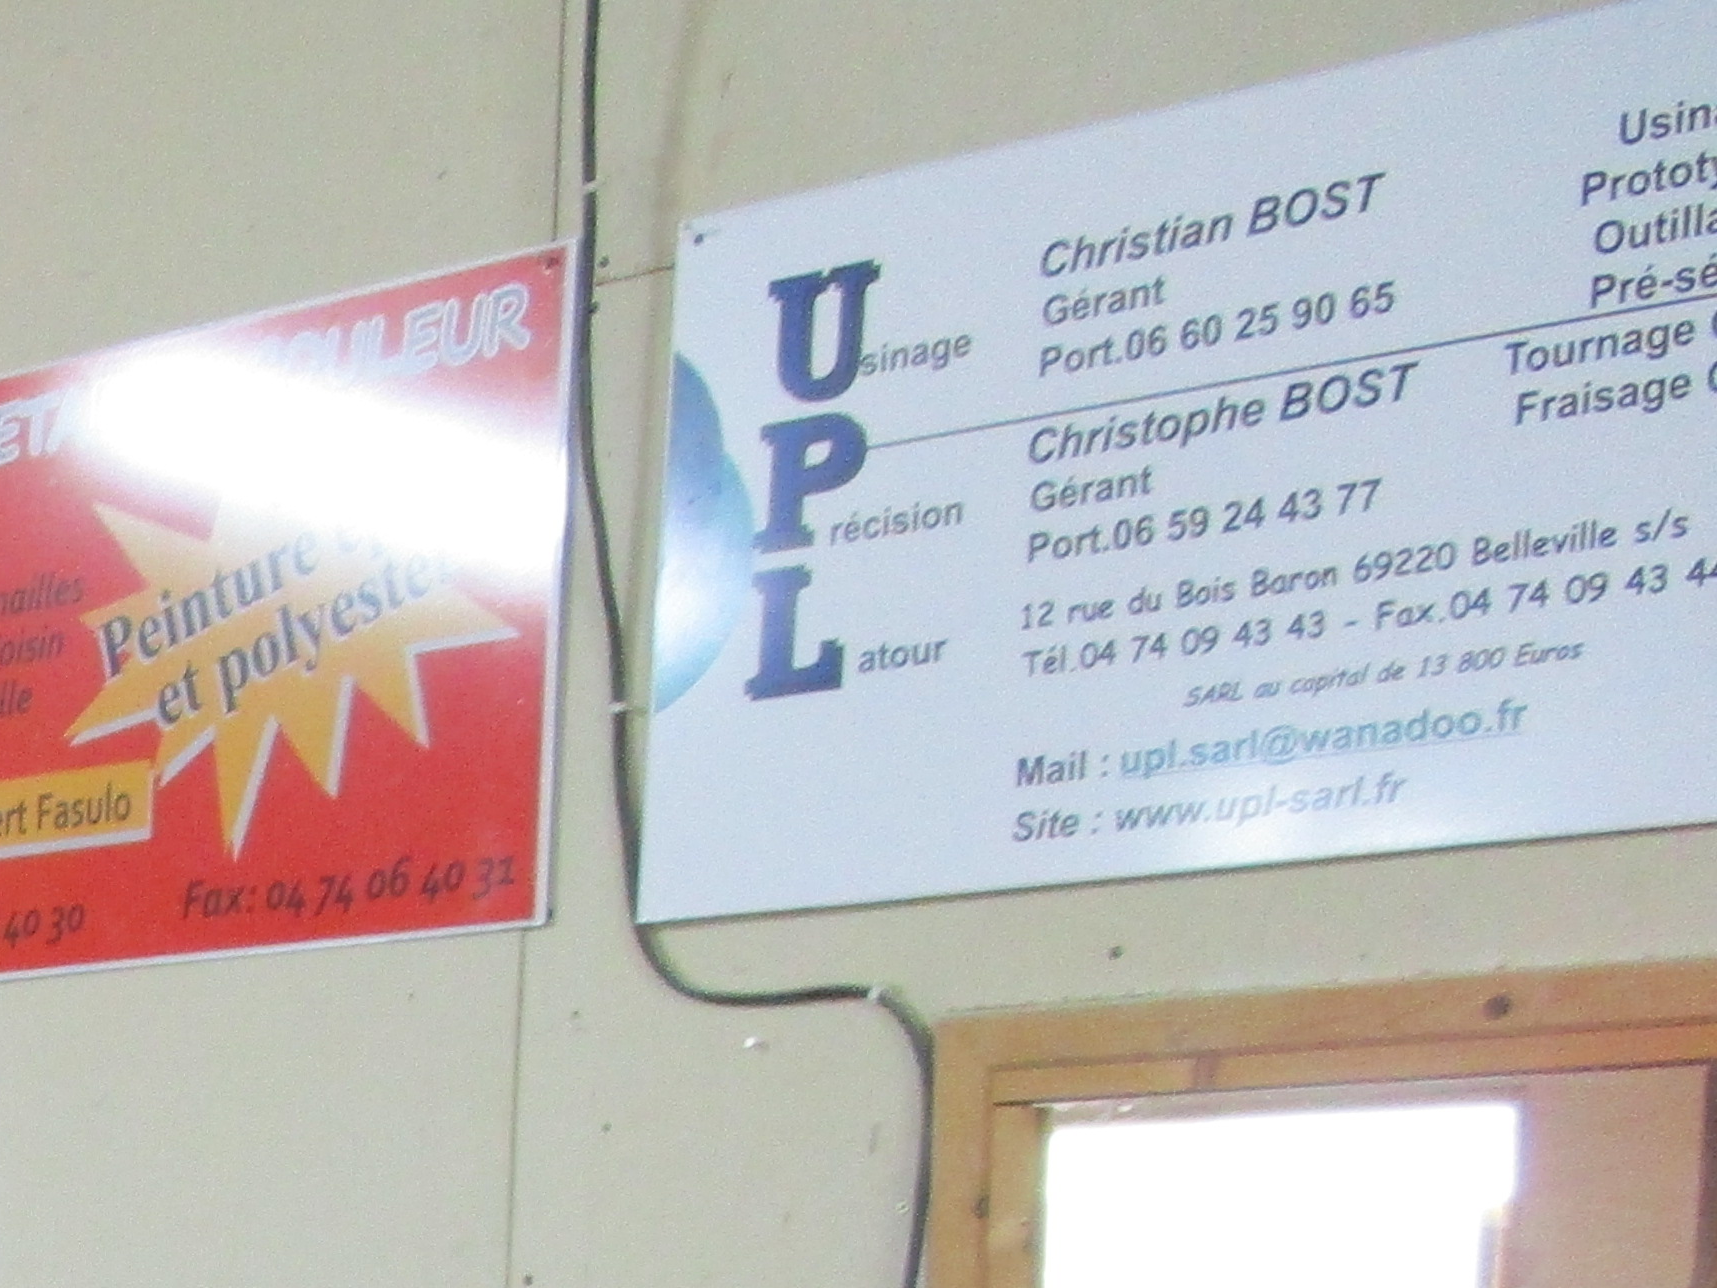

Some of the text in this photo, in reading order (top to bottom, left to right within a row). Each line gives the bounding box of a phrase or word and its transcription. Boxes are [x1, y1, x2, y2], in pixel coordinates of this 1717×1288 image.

[1619, 100, 1717, 145] Usin
[1040, 172, 1386, 277] Christian BOST
[1039, 280, 1395, 377] Port.06 60 25 90 65
[1043, 275, 1166, 326] Gérant
[1504, 319, 1695, 375] Tournage
[1028, 362, 1420, 464] Christophe BOST
[1515, 372, 1693, 426] Fraisage
[1027, 477, 1382, 562] Port.06 59 24 43 77
[1030, 466, 1153, 512] Gérant
[1021, 508, 1690, 631] 12 rue du Bois Baron 69220 Belleville s/s
[100, 529, 320, 682] Peinture
[159, 551, 457, 725] et polyeste
[1021, 638, 1116, 678] Tél.04
[1130, 632, 1168, 664] 74
[1180, 625, 1219, 656] 09
[1232, 618, 1272, 648] 43
[1287, 609, 1326, 640] 43
[1374, 586, 1492, 631] Fax.04
[1507, 578, 1549, 614] 74
[1565, 571, 1609, 605] 09
[1625, 563, 1668, 596] 43
[1376, 660, 1406, 683] de
[1016, 697, 1529, 787] Mail upl.sarl@wanadoo.fr
[37, 782, 132, 831] Fasulo
[1012, 809, 1080, 843] Site
[182, 879, 258, 920] Fax:
[266, 877, 307, 918] 04
[315, 872, 354, 917] 74
[367, 855, 411, 899] 06
[421, 858, 465, 901] 40
[4, 908, 41, 948] 40
[47, 903, 85, 946] 30
